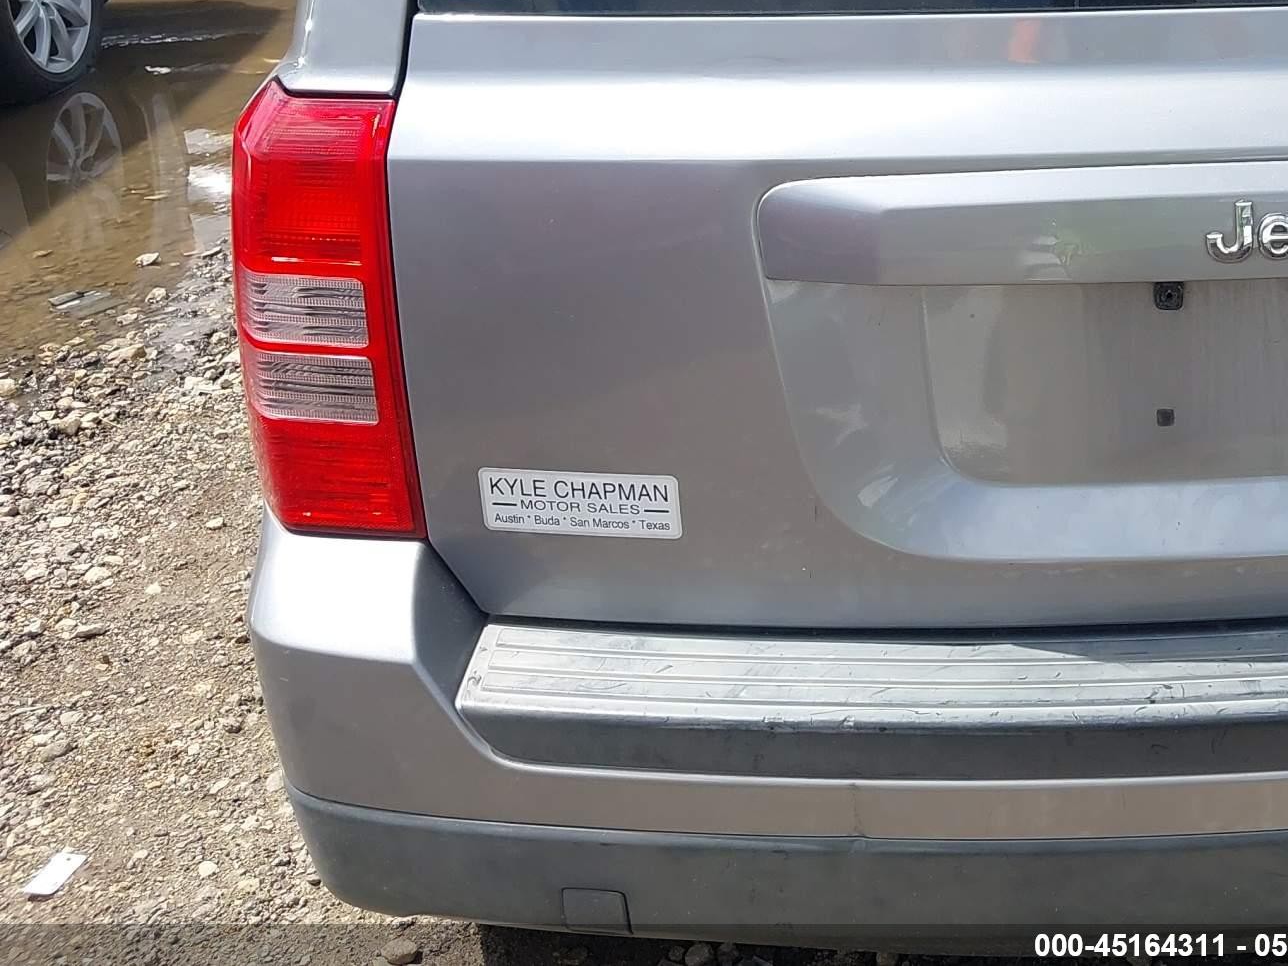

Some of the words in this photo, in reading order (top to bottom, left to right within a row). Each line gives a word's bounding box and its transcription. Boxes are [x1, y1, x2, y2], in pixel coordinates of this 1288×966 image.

[489, 477, 547, 498] KYLE
[553, 480, 669, 503] CHAPMAN
[520, 500, 581, 513] MOTOR
[587, 502, 641, 515] SALES
[494, 513, 525, 524] Austin
[534, 515, 561, 526] Buda
[570, 516, 590, 527] San
[592, 518, 630, 530] Marcos
[639, 519, 671, 531] Texas
